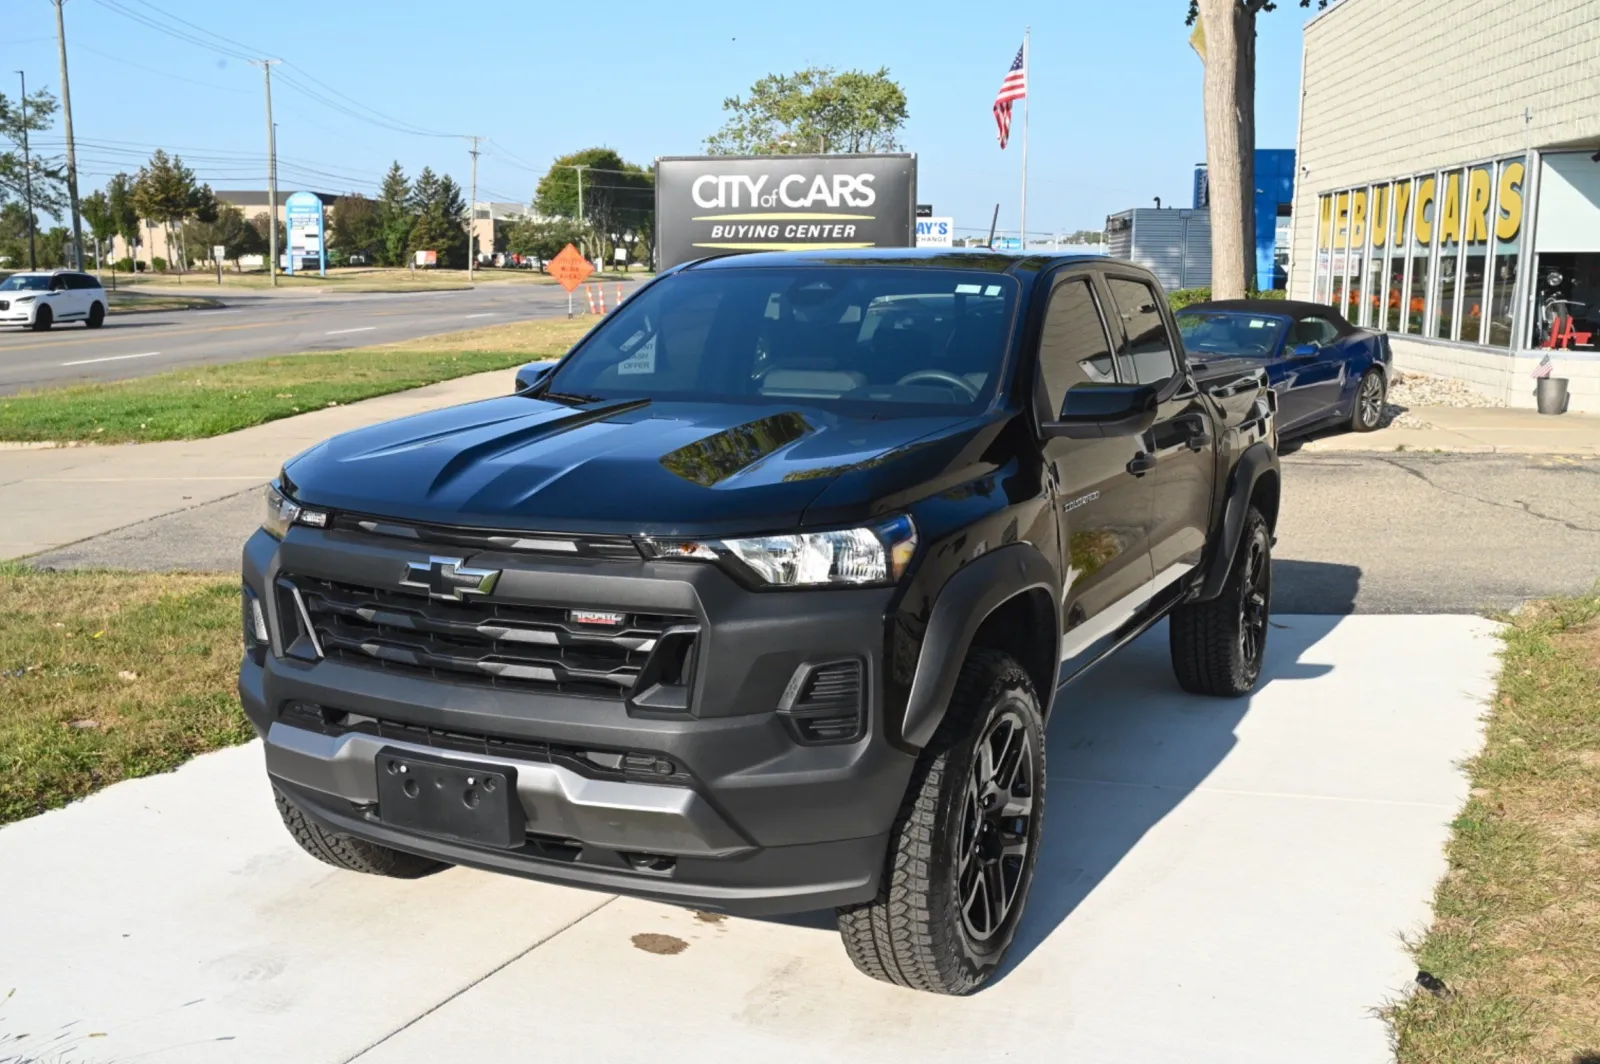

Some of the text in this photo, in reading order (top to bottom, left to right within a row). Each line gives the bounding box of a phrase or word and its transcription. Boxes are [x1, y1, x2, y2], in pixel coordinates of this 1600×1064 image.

[692, 173, 876, 209] CITY of CARS
[711, 224, 856, 238] BUYING CENTER
[916, 221, 948, 235] AY'S
